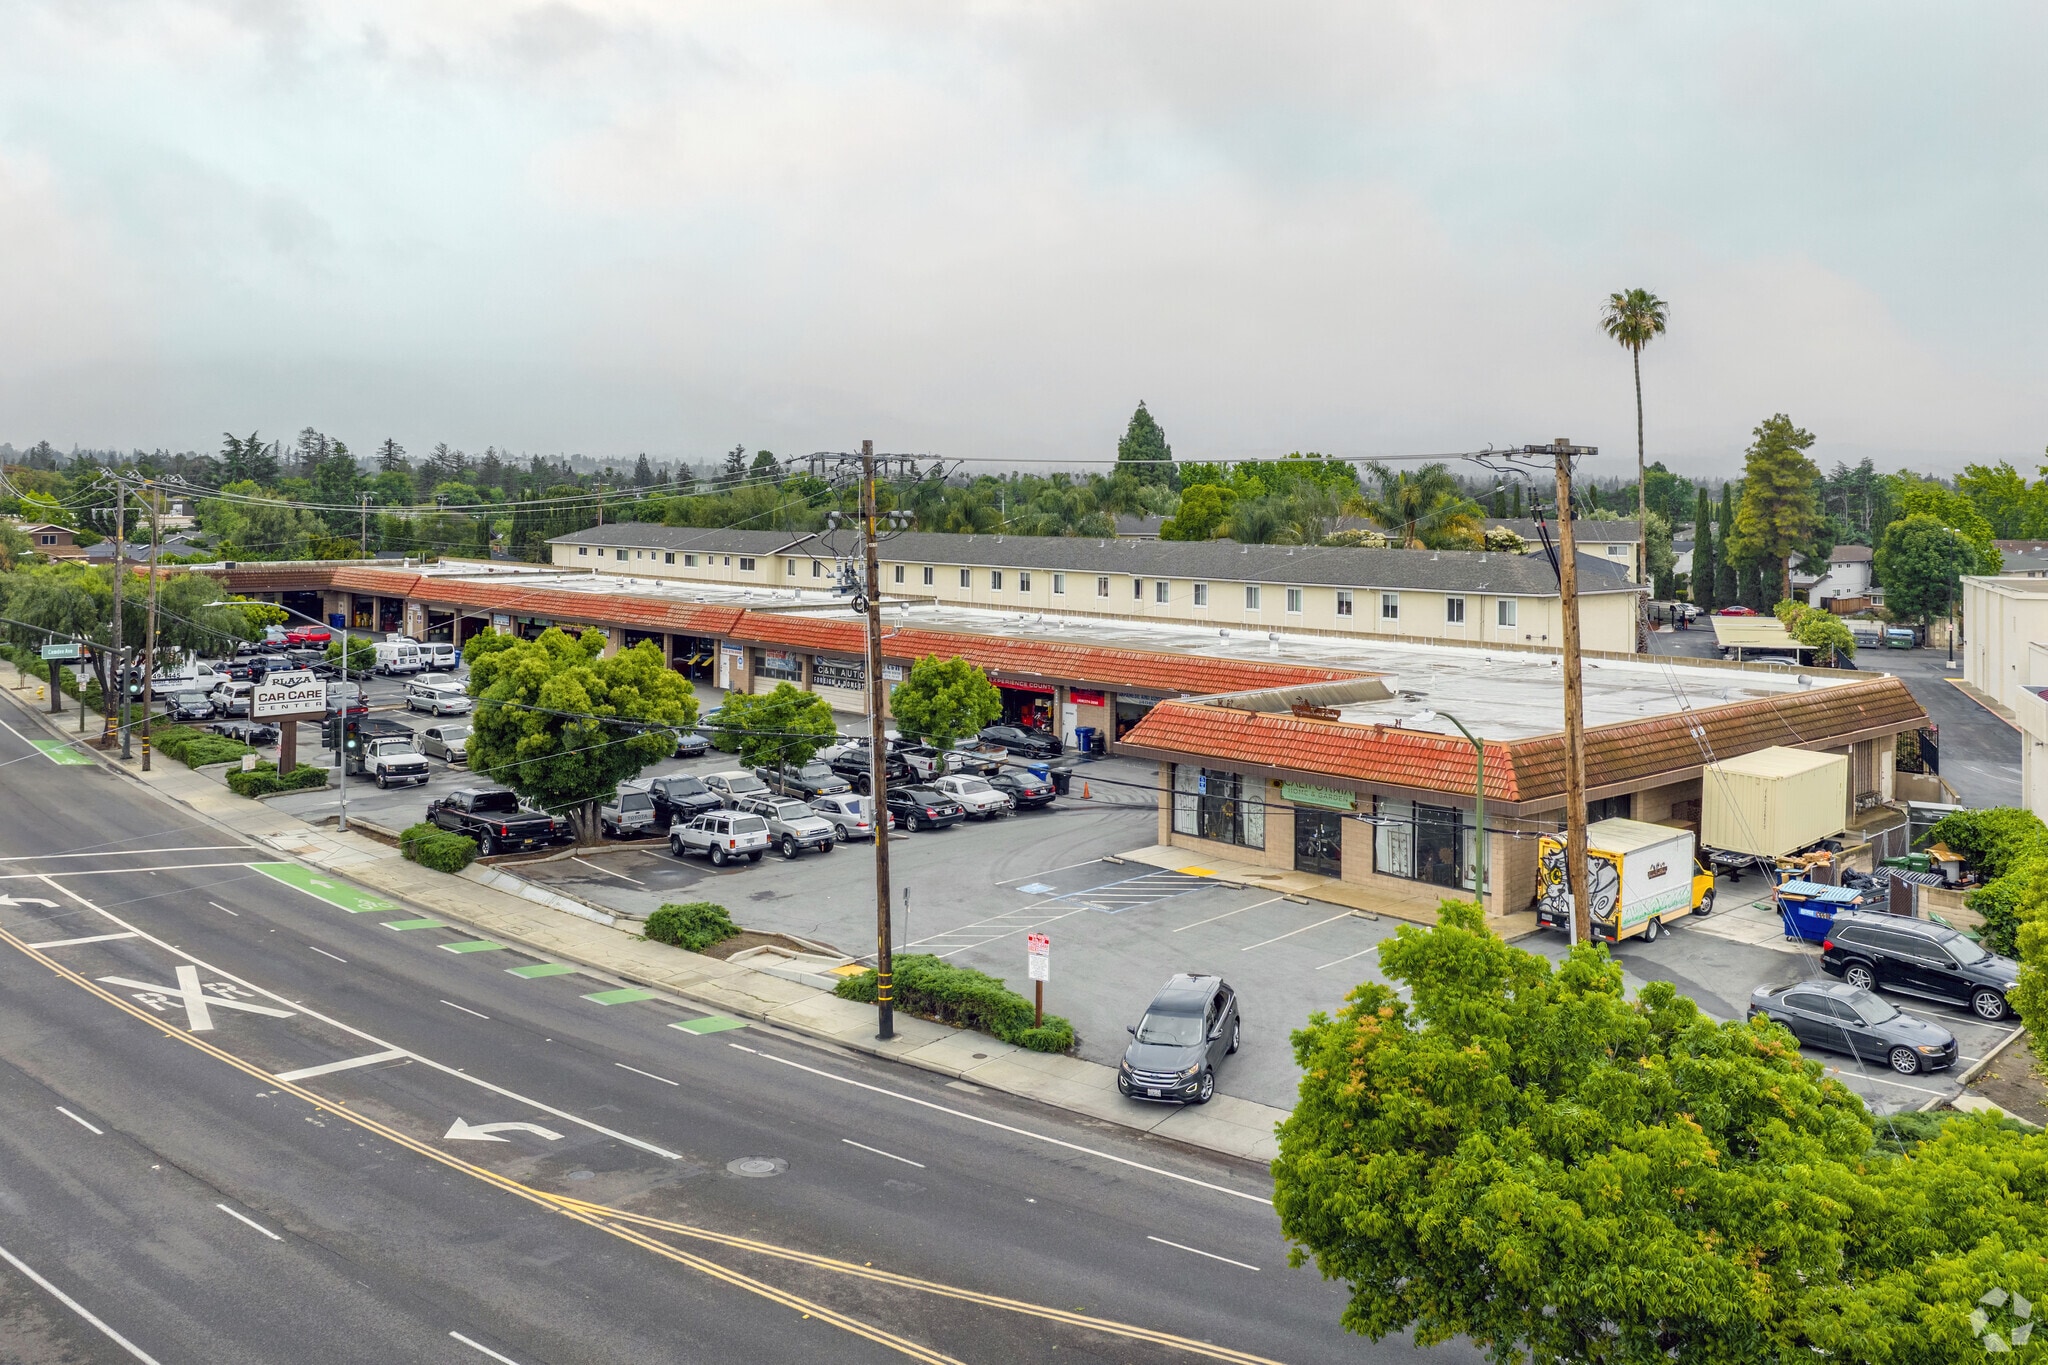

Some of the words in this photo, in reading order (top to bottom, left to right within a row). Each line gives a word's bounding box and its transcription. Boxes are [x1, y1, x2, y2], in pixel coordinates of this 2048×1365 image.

[818, 666, 835, 675] C&N
[840, 669, 865, 679] AUTO
[271, 676, 312, 686] PLAZA
[988, 677, 1028, 688] EXPERIENCE
[258, 693, 286, 702] CAR
[288, 689, 322, 700] CARE
[258, 702, 322, 711] CENTER
[1288, 788, 1309, 796] HOME
[1318, 792, 1348, 802] GARDEN
